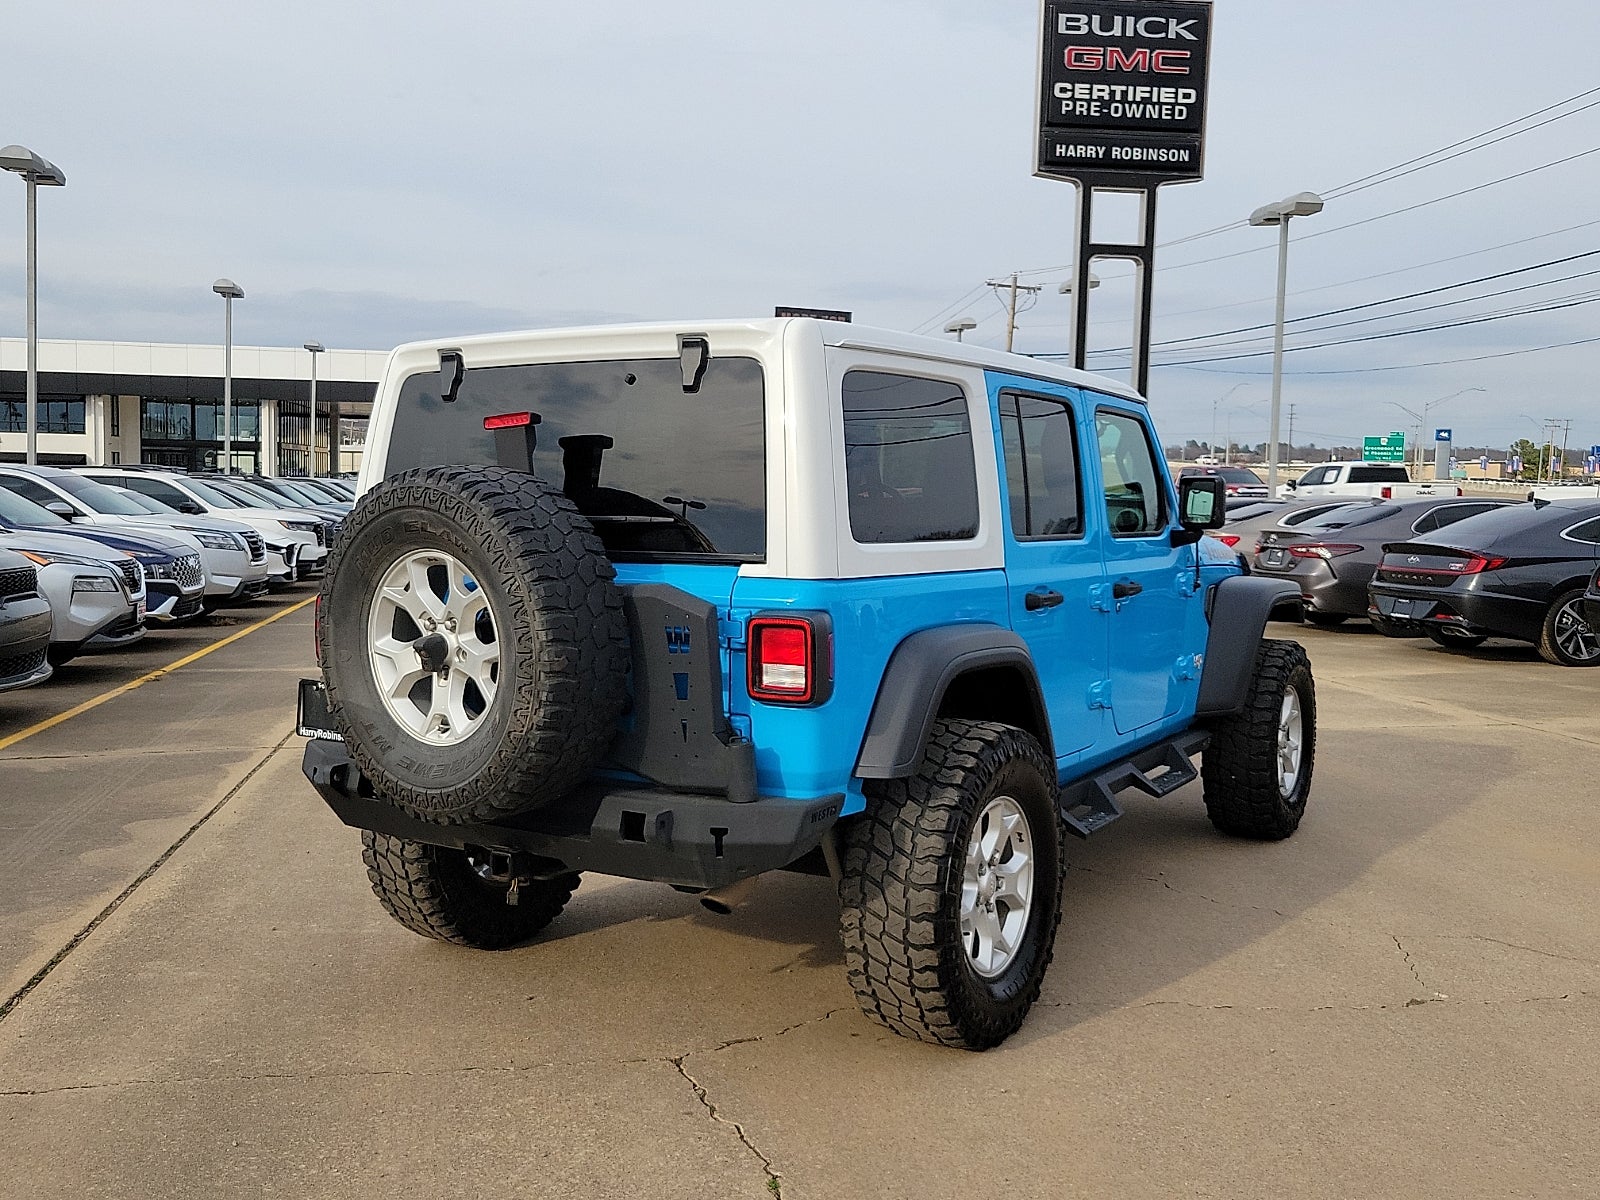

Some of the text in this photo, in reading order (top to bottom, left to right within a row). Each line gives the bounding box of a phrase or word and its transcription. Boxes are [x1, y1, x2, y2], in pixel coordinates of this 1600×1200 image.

[1057, 13, 1199, 40] BUICK
[1064, 45, 1191, 74] GMC
[1053, 82, 1197, 104] CERTIFIED
[1061, 100, 1188, 120] PRE-OWNED
[1055, 144, 1190, 161] HARRY ROBINSON
